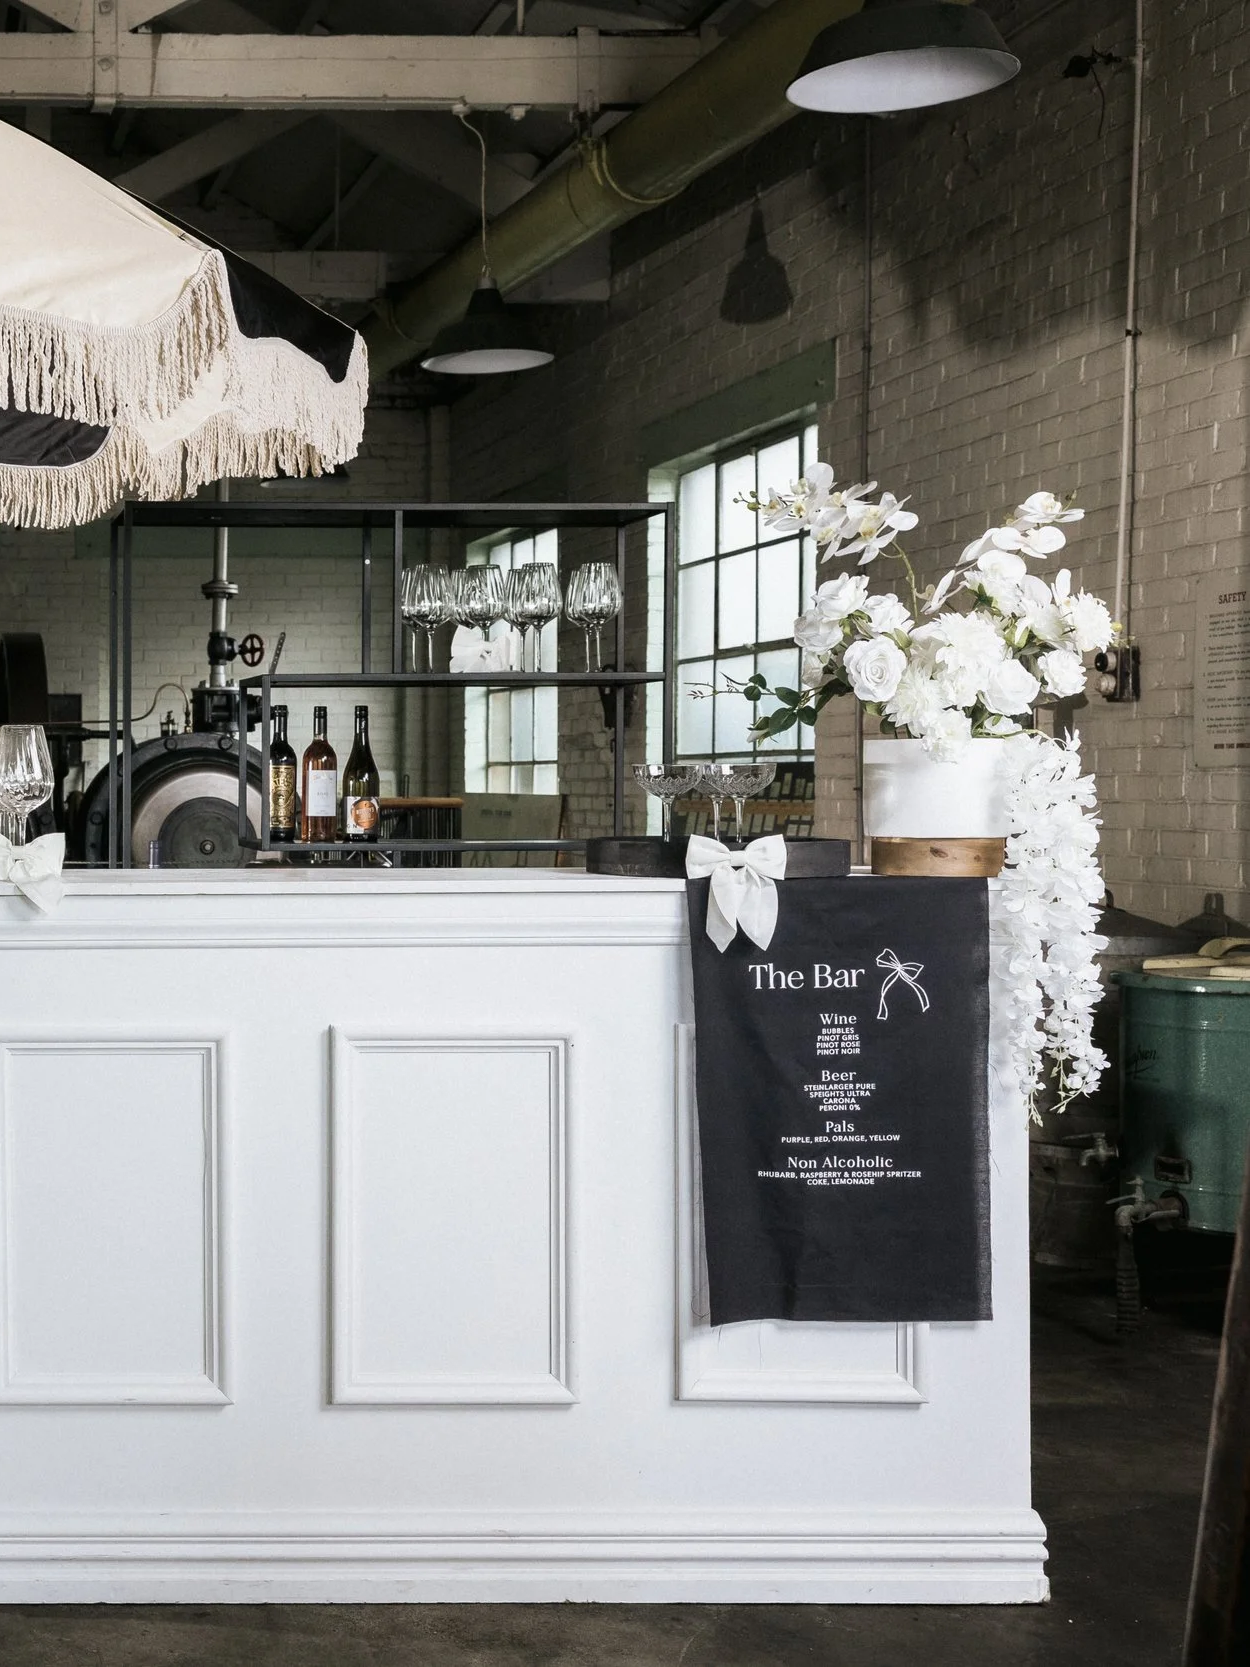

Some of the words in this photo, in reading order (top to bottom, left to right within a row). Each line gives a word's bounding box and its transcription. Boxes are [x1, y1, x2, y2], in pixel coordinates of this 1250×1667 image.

[1218, 591, 1247, 604] SAFETY
[749, 963, 804, 990] The
[814, 964, 865, 988] Bar
[820, 1014, 857, 1024] Wine
[821, 1070, 856, 1082] Beer
[825, 1121, 854, 1132] Pals
[788, 1157, 817, 1168] Non
[822, 1156, 893, 1168] Alcoholic
[758, 1171, 798, 1179] RHUBARB,
